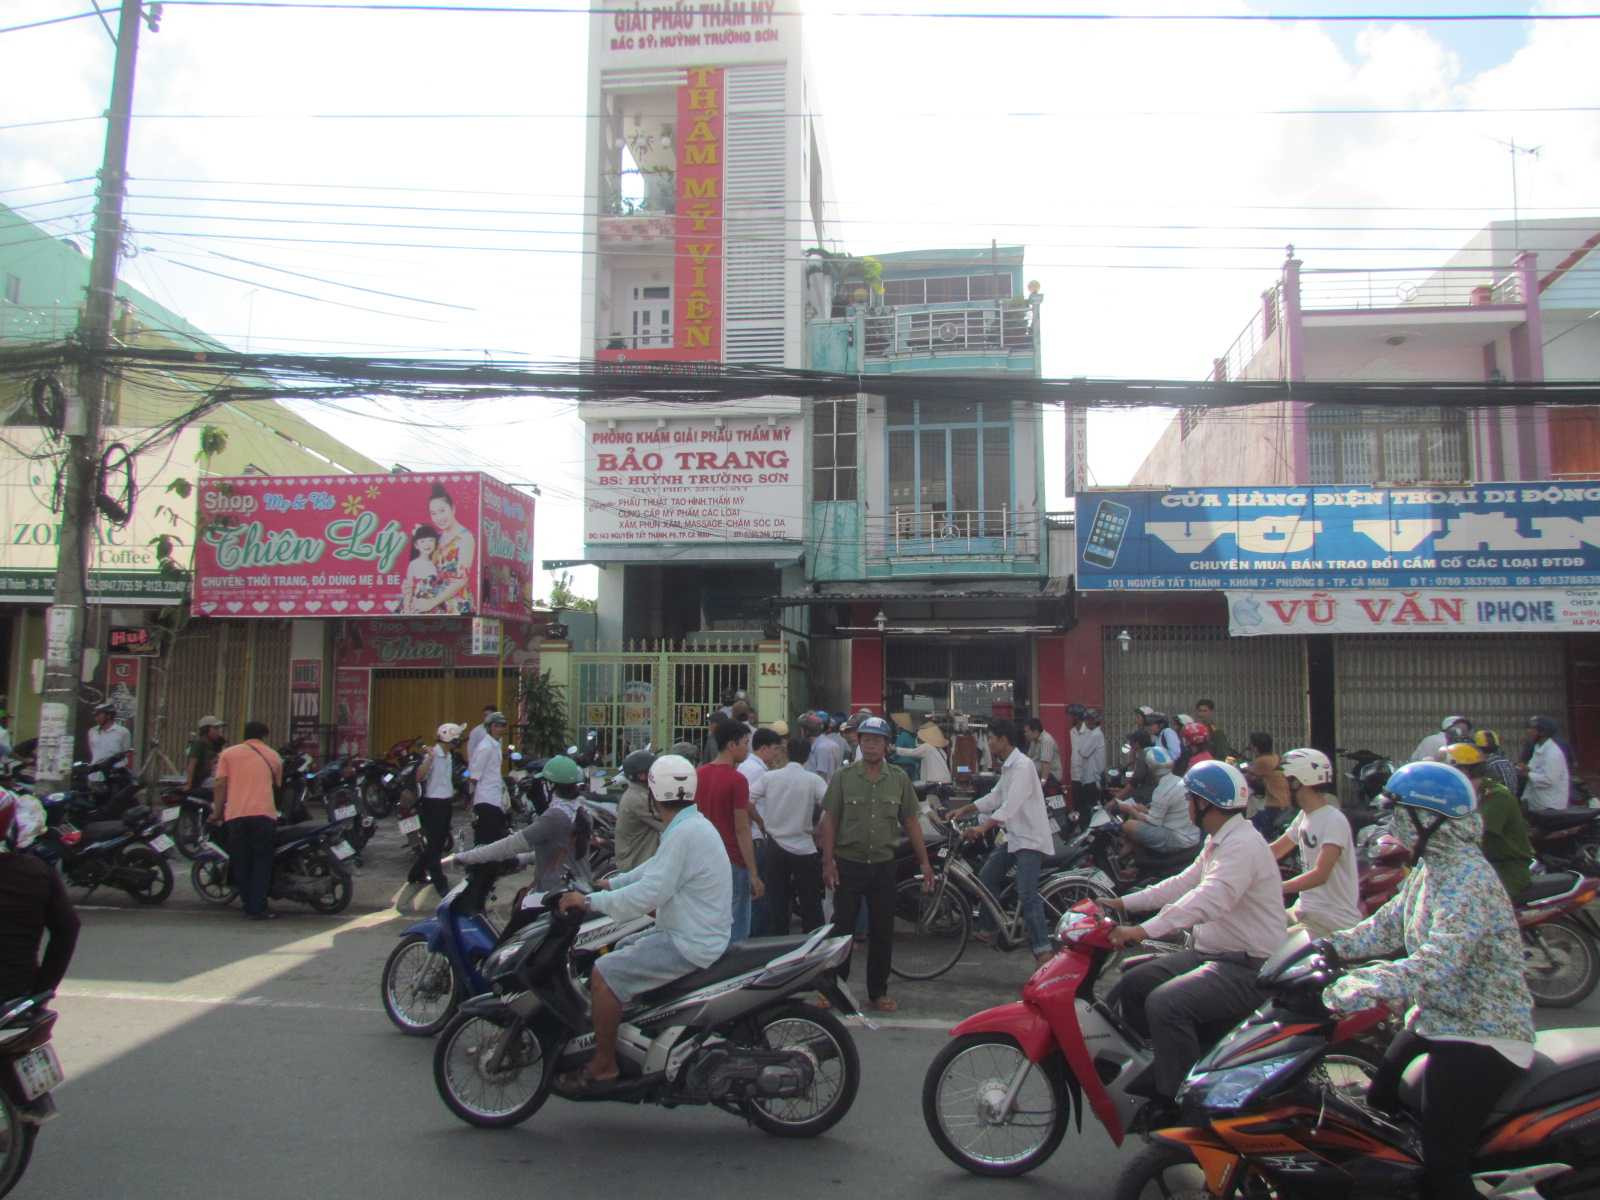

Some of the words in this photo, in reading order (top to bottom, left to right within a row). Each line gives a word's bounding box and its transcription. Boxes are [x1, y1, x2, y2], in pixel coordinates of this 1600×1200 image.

[611, 36, 633, 50] BÁC
[682, 243, 717, 348] VIỆN
[674, 427, 698, 443] GIẢI
[597, 446, 663, 471] BẢO
[674, 449, 789, 470] TRANG
[600, 475, 623, 485] BS:
[628, 472, 683, 485] HUỲNH
[688, 471, 753, 484] TRƯỜNG
[758, 472, 789, 484] SƠN
[204, 491, 258, 516] Shop
[1161, 491, 1222, 507] CỬA
[1227, 491, 1308, 507] HÀNG
[1313, 489, 1383, 508] ĐIỆN
[1390, 490, 1478, 506] THOẠI
[1484, 490, 1516, 504] DI
[204, 520, 325, 571] Thiên
[325, 511, 408, 574] Lý
[101, 550, 150, 564] Coffee
[1190, 559, 1249, 570] CHUYÊN
[1254, 561, 1286, 570] MUA
[1291, 559, 1323, 570] BÁN
[1328, 559, 1368, 569] TRAO
[1467, 556, 1497, 568] CÁC
[1503, 557, 1537, 569] LOẠI
[329, 572, 356, 586] DÙNG
[359, 575, 373, 588] MẸ
[377, 575, 384, 585] &
[1107, 578, 1124, 588] 101
[1351, 576, 1365, 587] CÀ
[1367, 577, 1389, 587] MAU
[1267, 592, 1340, 625] VŨ
[1354, 592, 1467, 625] VĂN
[1477, 601, 1555, 623] IPHONE
